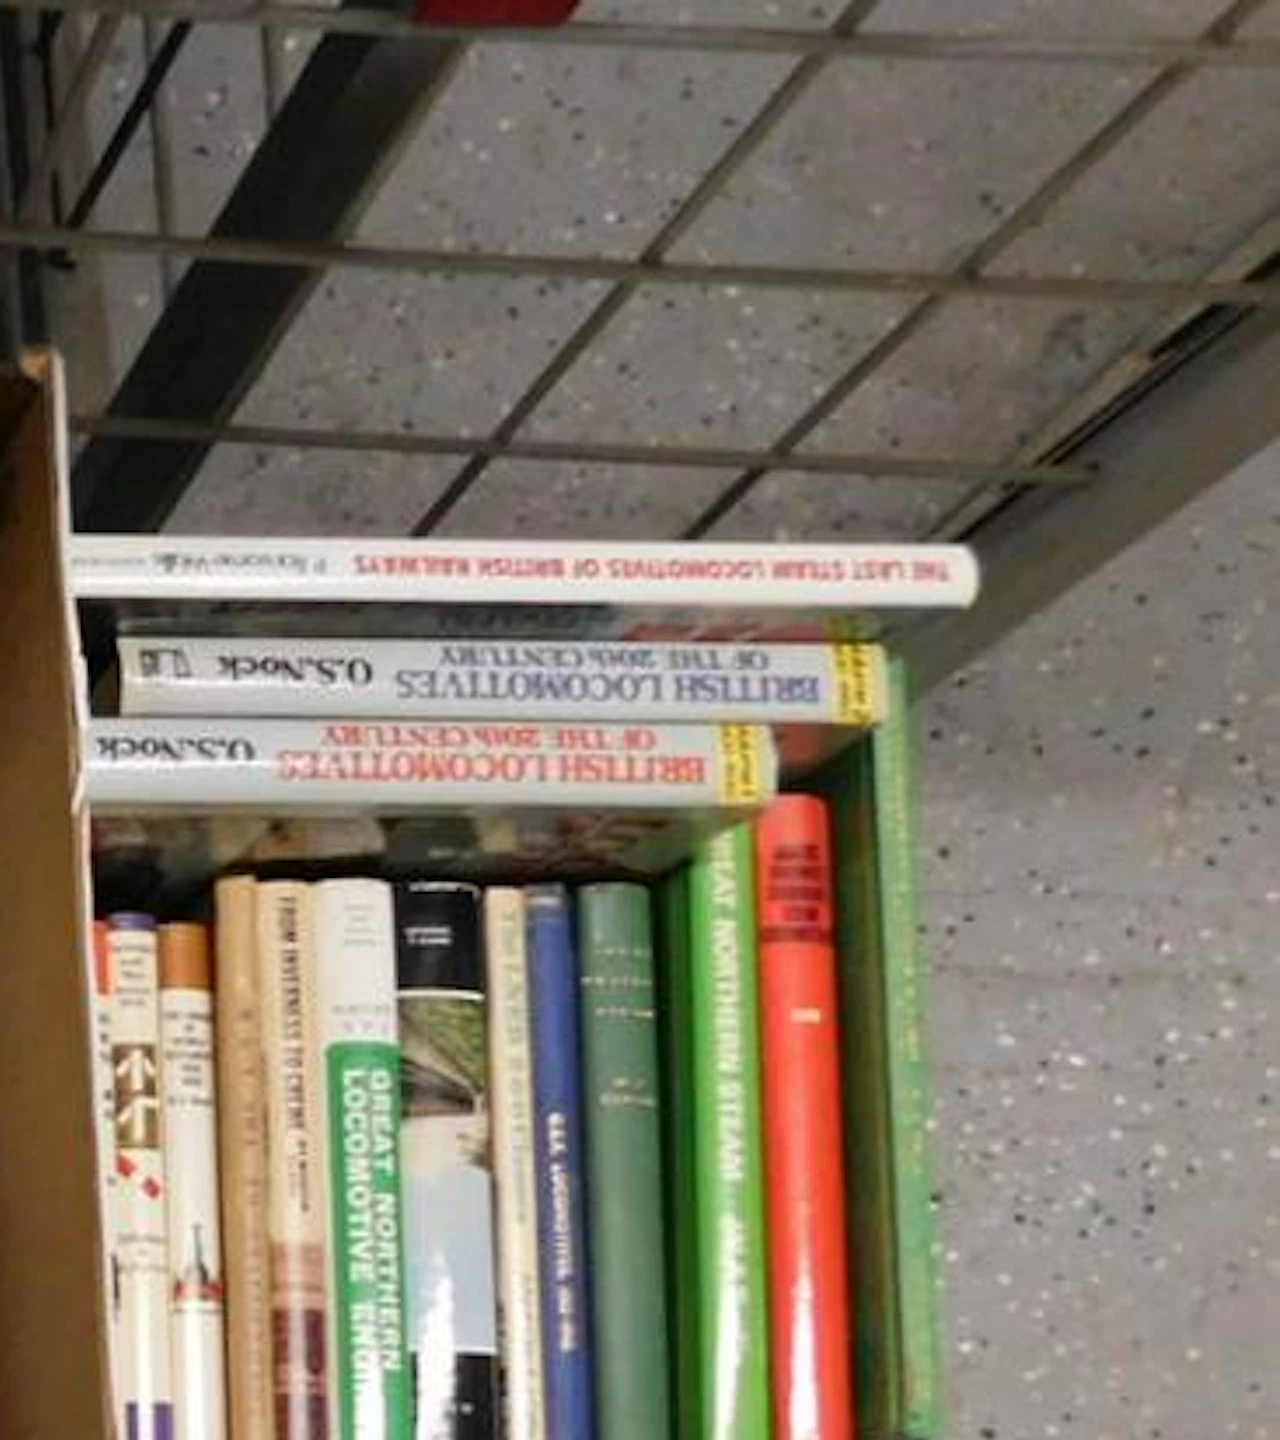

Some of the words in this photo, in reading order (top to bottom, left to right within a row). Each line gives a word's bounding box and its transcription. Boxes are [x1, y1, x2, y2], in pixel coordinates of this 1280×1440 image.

[354, 553, 471, 579] RAILWAYS
[476, 556, 566, 581] BRITISH
[570, 557, 602, 581] OF
[608, 557, 767, 583] LOCOMOTIVES
[850, 559, 905, 584] LAST
[912, 560, 951, 584] THE
[218, 655, 375, 685] O.S.Nock
[396, 668, 664, 702] LOCOMOTIVES
[674, 672, 821, 702] BRITISH
[95, 735, 256, 766] O.S.Nock
[277, 747, 547, 784] LOCOMOTIVES
[557, 754, 708, 784] BRITISH
[371, 1068, 397, 1176] GREAT
[718, 1081, 746, 1183] STEAM
[343, 1068, 375, 1283] LOCOMOTIVE
[374, 1195, 402, 1372] NORTHERN
